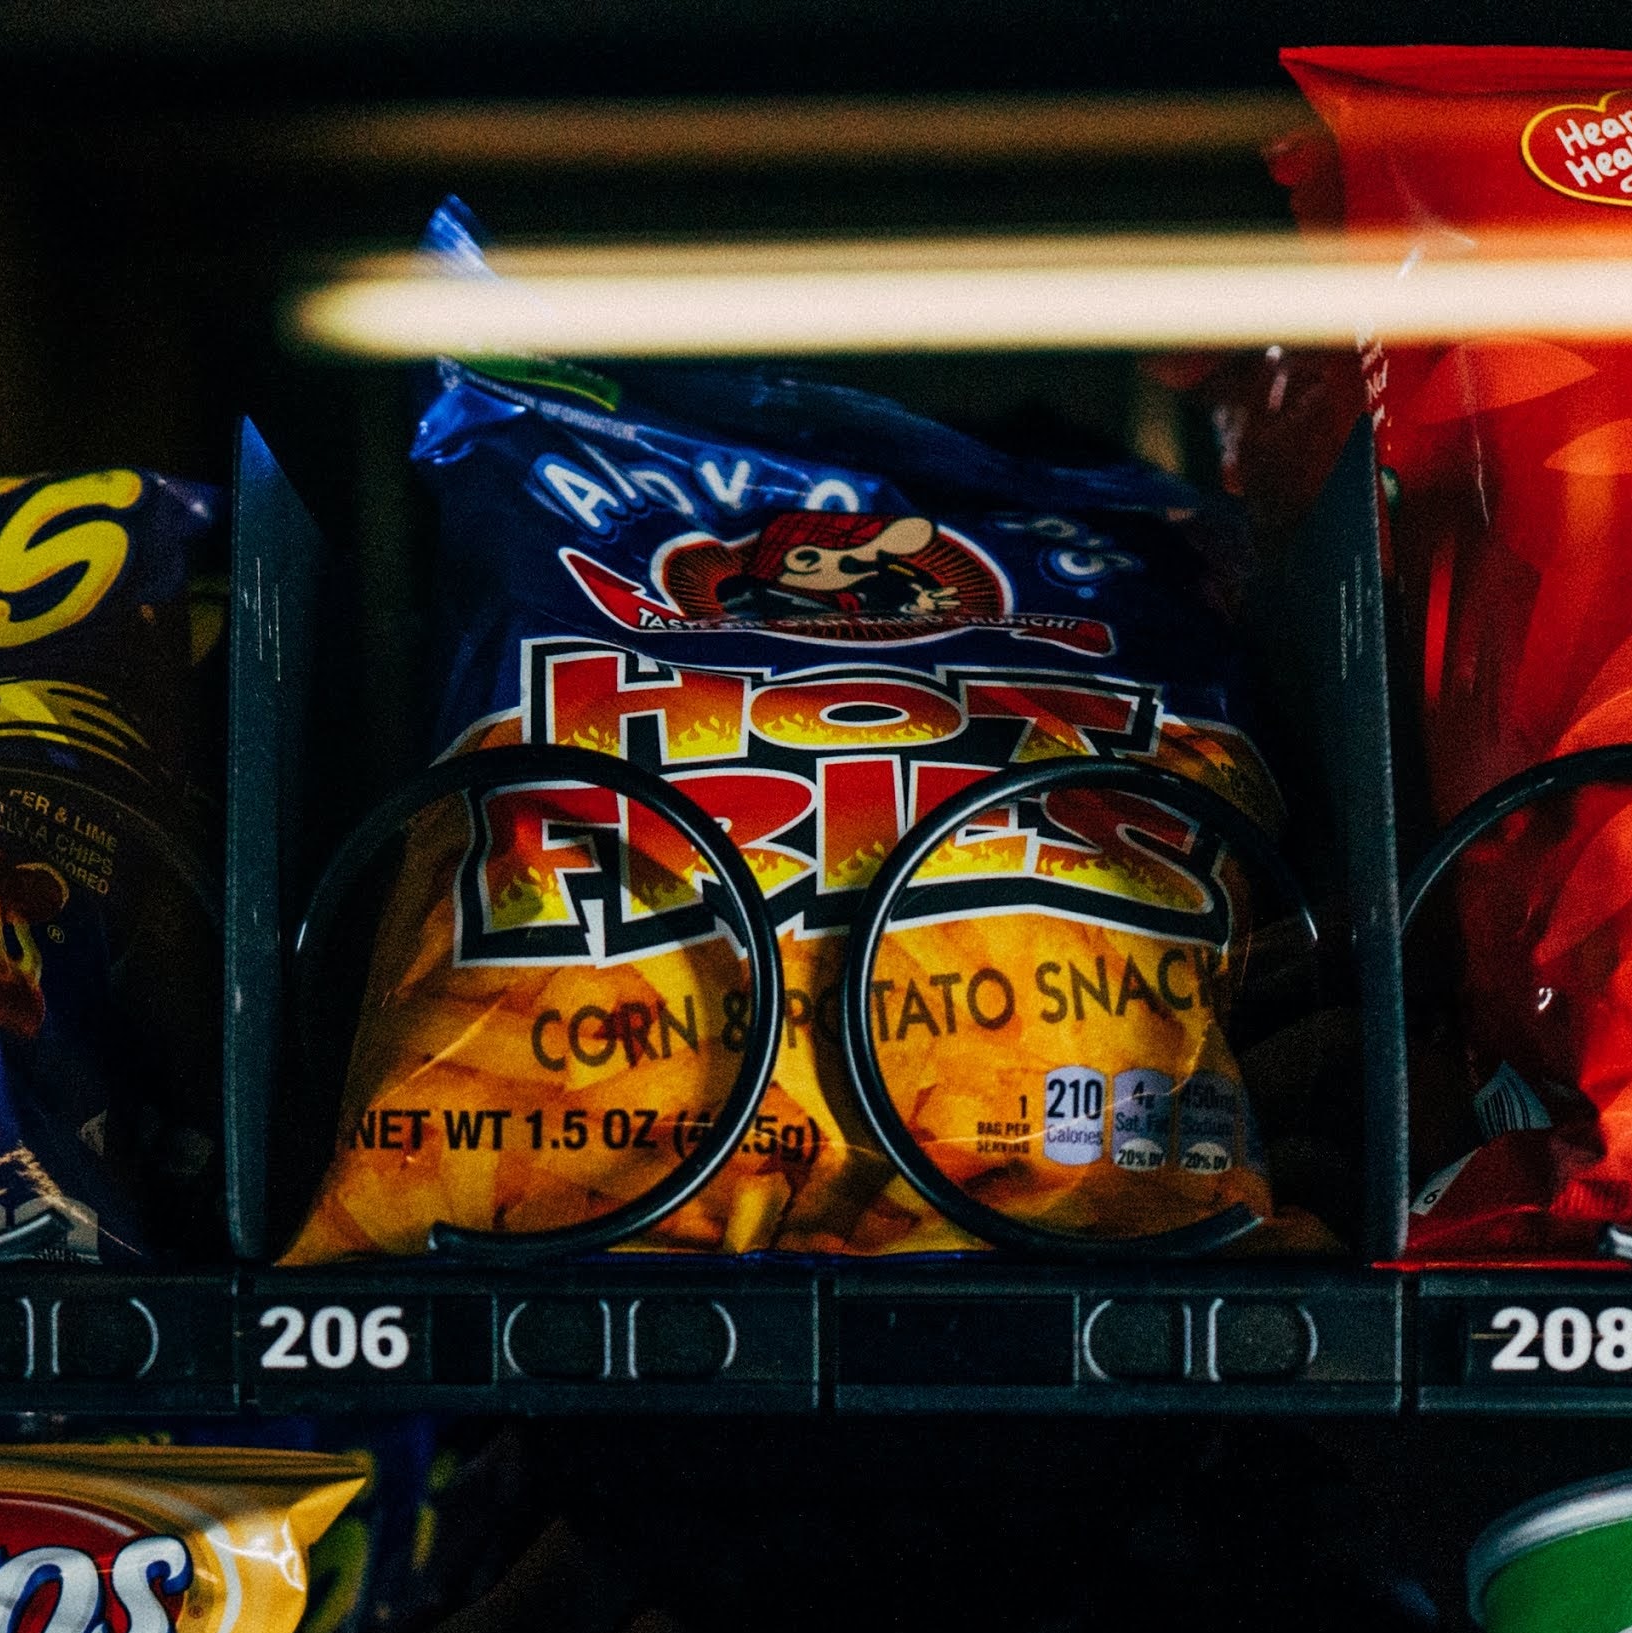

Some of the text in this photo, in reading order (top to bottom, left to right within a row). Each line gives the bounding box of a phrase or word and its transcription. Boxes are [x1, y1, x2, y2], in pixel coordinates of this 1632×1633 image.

[532, 645, 1155, 762] HOT
[475, 755, 1227, 932] FRIES
[530, 995, 701, 1073] CORN
[348, 1109, 660, 1151] NET WT 1.5 OZ
[1046, 1077, 1103, 1120] 210
[1046, 1125, 1105, 1147] Calories
[258, 1307, 411, 1370] 206
